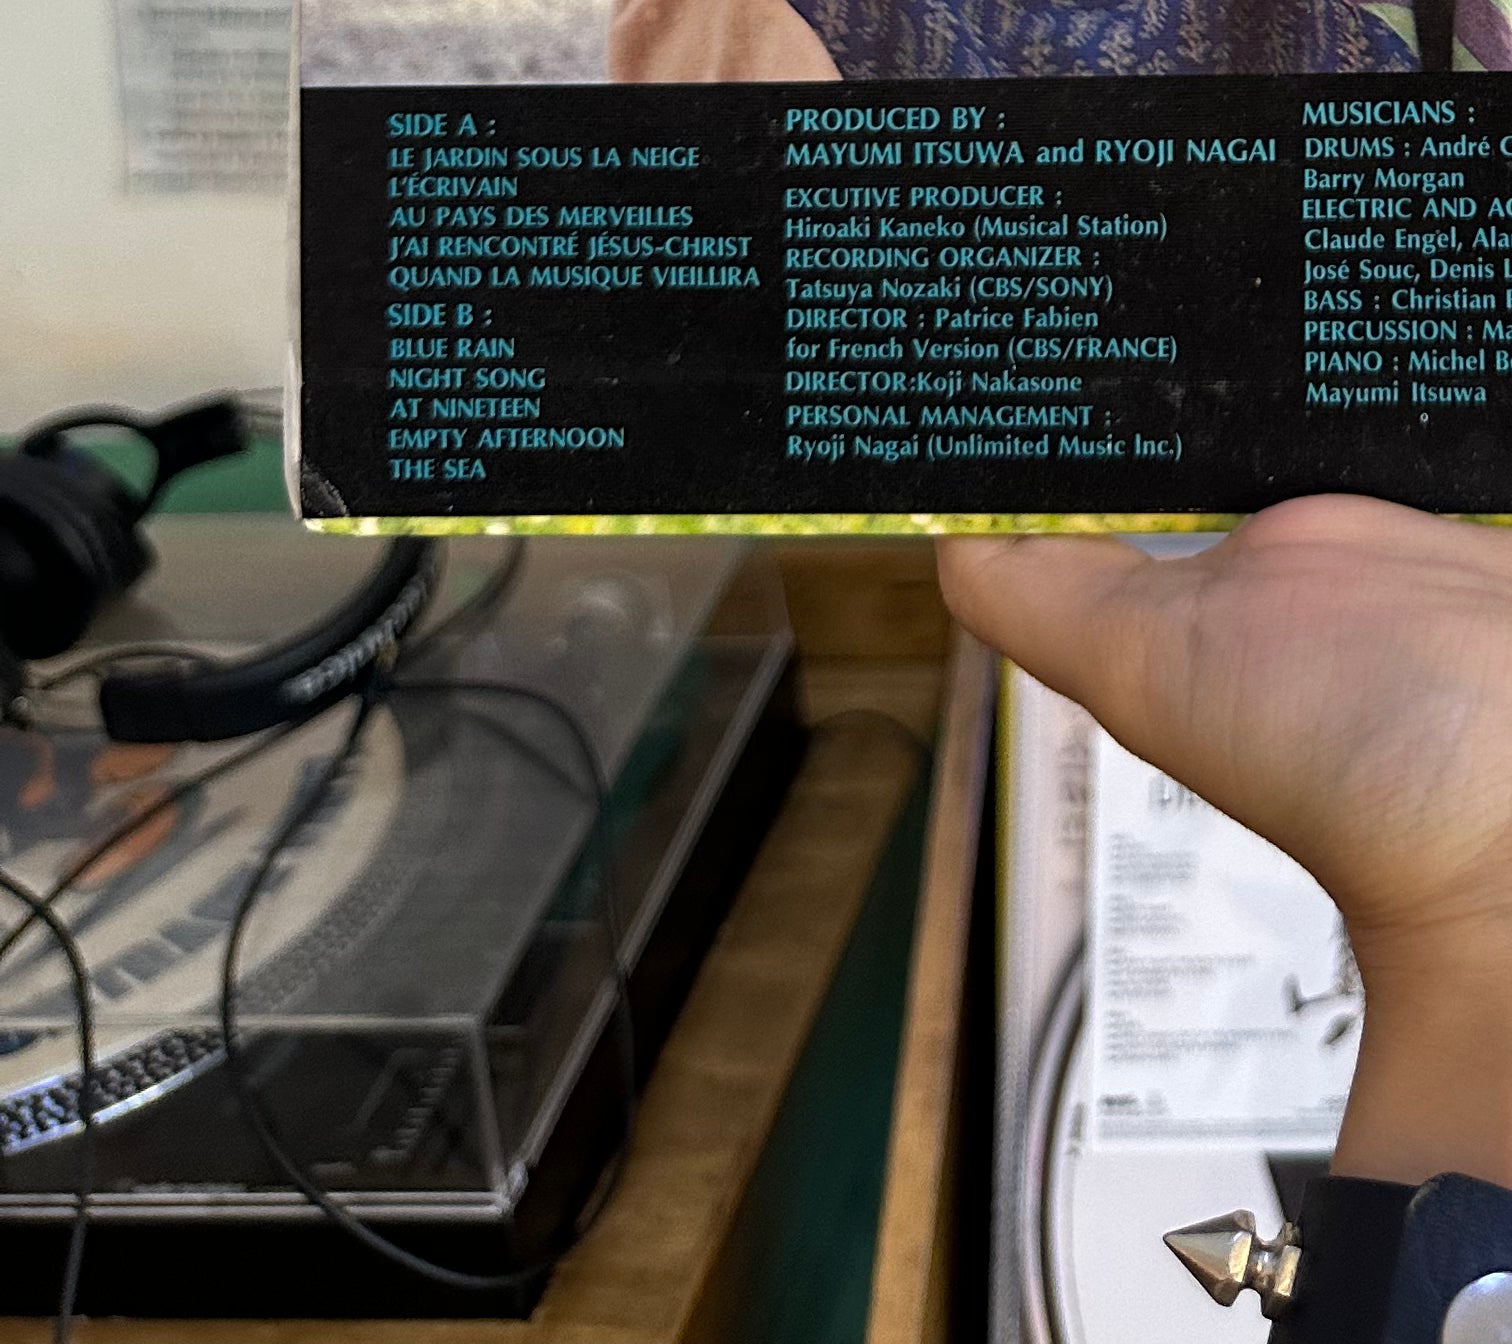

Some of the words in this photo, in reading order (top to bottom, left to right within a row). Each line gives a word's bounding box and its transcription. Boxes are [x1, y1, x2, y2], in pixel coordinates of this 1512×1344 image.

[786, 107, 941, 132] PRODUCED
[952, 106, 986, 130] BY
[1302, 100, 1456, 125] MUSICIANS
[389, 113, 447, 137] SIDE
[457, 113, 478, 136] A
[785, 142, 902, 166] MAYUMI
[914, 140, 1025, 166] ITSUWA
[1036, 138, 1084, 164] and
[1096, 139, 1174, 167] RYOJI
[1187, 138, 1276, 162] NAGAI
[1305, 136, 1395, 158] DRUMS
[1420, 134, 1491, 157] André
[390, 147, 414, 168] LE
[424, 147, 508, 173] JARDIN
[517, 147, 583, 168] SOUS
[591, 147, 622, 168] LA
[632, 146, 699, 168] NEIGE
[1304, 168, 1365, 195] Barry
[1374, 167, 1465, 194] Morgan
[785, 187, 900, 209] EXCUTIVE
[910, 185, 1044, 207] PRODUCER
[1302, 197, 1412, 220] ELECTRIC
[1422, 197, 1477, 218] AND
[389, 206, 426, 228] AU
[436, 205, 497, 227] PAYS
[506, 206, 550, 227] DES
[558, 206, 693, 227] MERVEILLES
[786, 215, 871, 239] Hiroaki
[879, 215, 966, 238] Kaneko
[974, 213, 1068, 242] (Musical
[1077, 213, 1167, 241] Station)
[437, 232, 579, 257] RENCONTRÉ
[588, 231, 753, 261] JÉSUS-CHRIST
[388, 266, 482, 292] QUAND
[491, 266, 521, 287] LA
[530, 265, 643, 291] MUSIQUE
[652, 266, 760, 287] VIEILLIRA
[387, 303, 446, 327] SIDE
[456, 303, 474, 327] B
[787, 307, 908, 329] DIRECTOR
[935, 306, 1014, 329] Patrice
[1023, 305, 1099, 328] Fabien
[390, 337, 448, 360] BLUE
[456, 337, 515, 358] RAIN
[787, 336, 821, 359] for
[828, 336, 903, 359] French
[912, 336, 999, 359] Version
[1008, 335, 1177, 363] (CBS/FRANCE)
[1305, 350, 1383, 373] PIANO
[1408, 348, 1485, 371] Michel
[389, 367, 466, 389] NIGHT
[475, 367, 546, 389] SONG
[972, 368, 1082, 392] Nakasone
[1306, 380, 1399, 409] Mayumi
[1412, 381, 1487, 403] Itsuwa
[390, 397, 423, 419] AT
[432, 397, 541, 419] NINETEEN
[389, 428, 468, 449] EMPTY
[478, 427, 625, 449] AFTERNOON
[390, 458, 435, 479] THE
[444, 458, 486, 480] SEA
